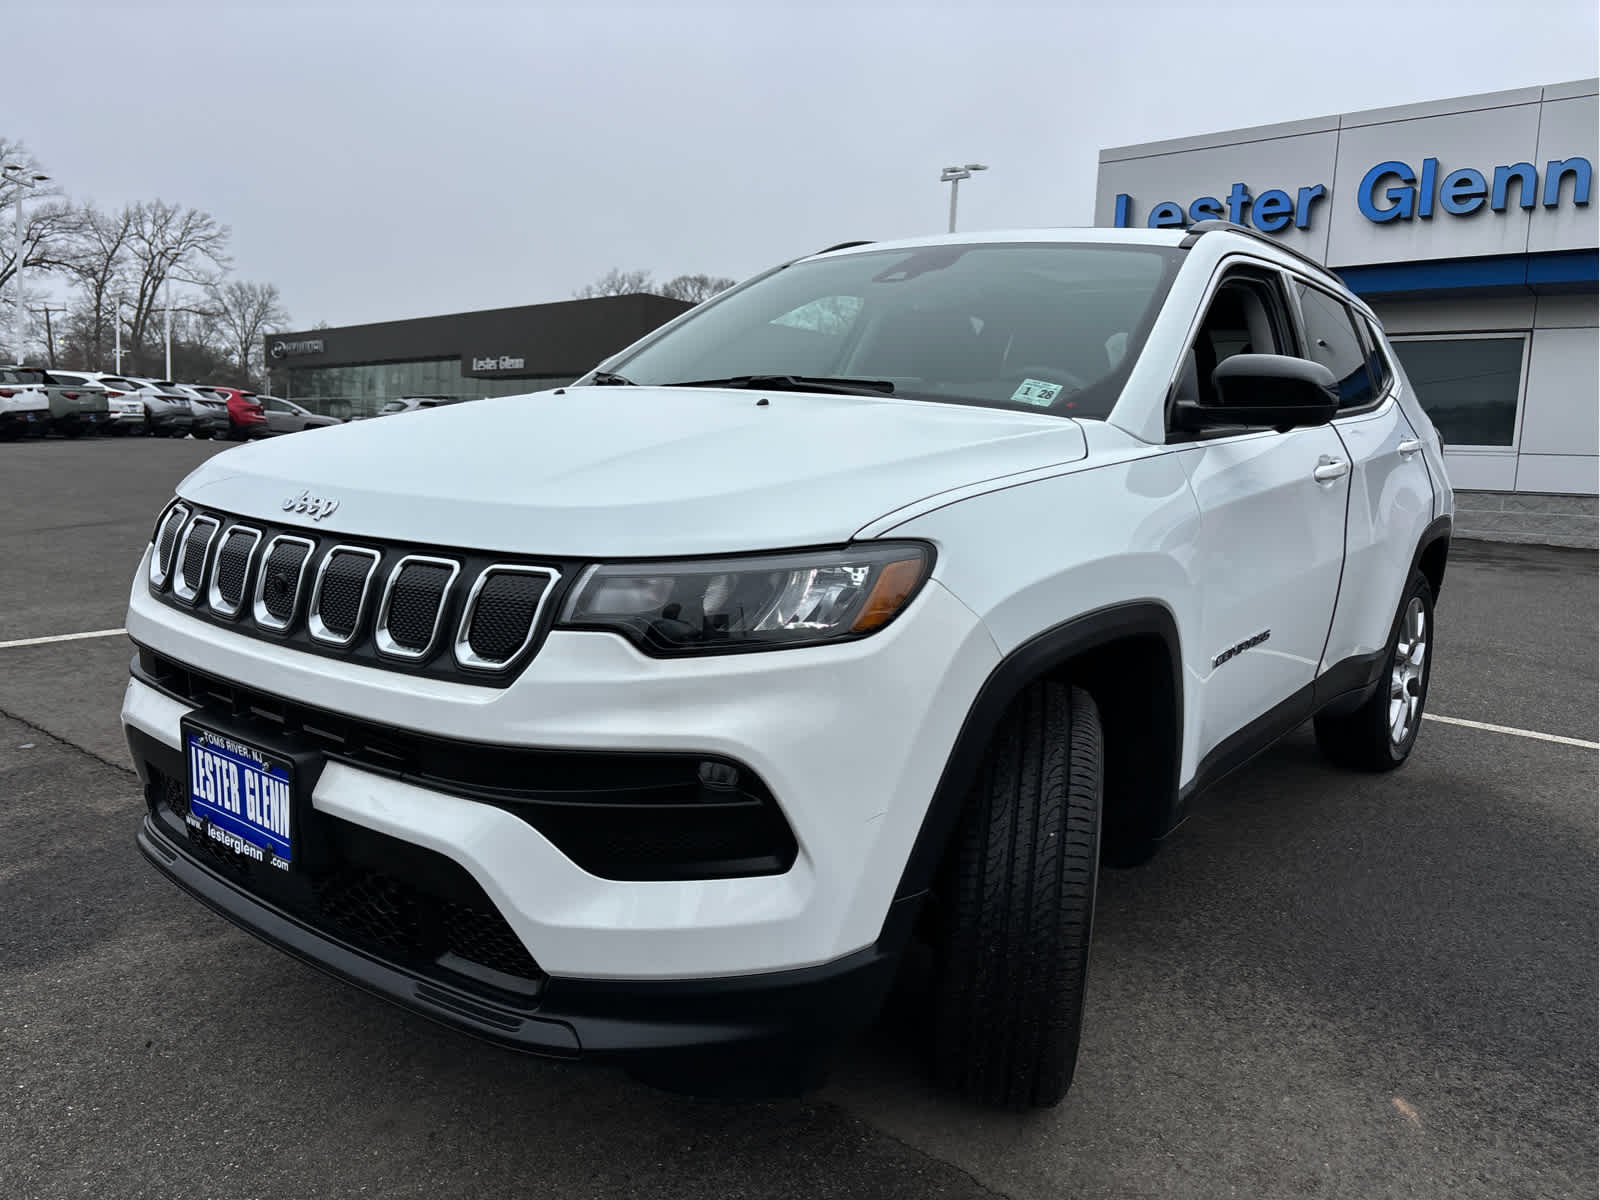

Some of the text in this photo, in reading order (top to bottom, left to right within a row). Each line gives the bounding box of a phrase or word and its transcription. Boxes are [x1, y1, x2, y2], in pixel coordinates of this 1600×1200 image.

[1114, 157, 1592, 232] Lester Glenn
[1037, 389, 1055, 400] 28
[281, 489, 341, 522] Jeep
[203, 731, 225, 749] TOMS
[252, 750, 263, 763] NJ
[191, 746, 290, 838] LESTER GLENN
[207, 823, 264, 862] lesterglenn
[270, 857, 289, 872] .com
